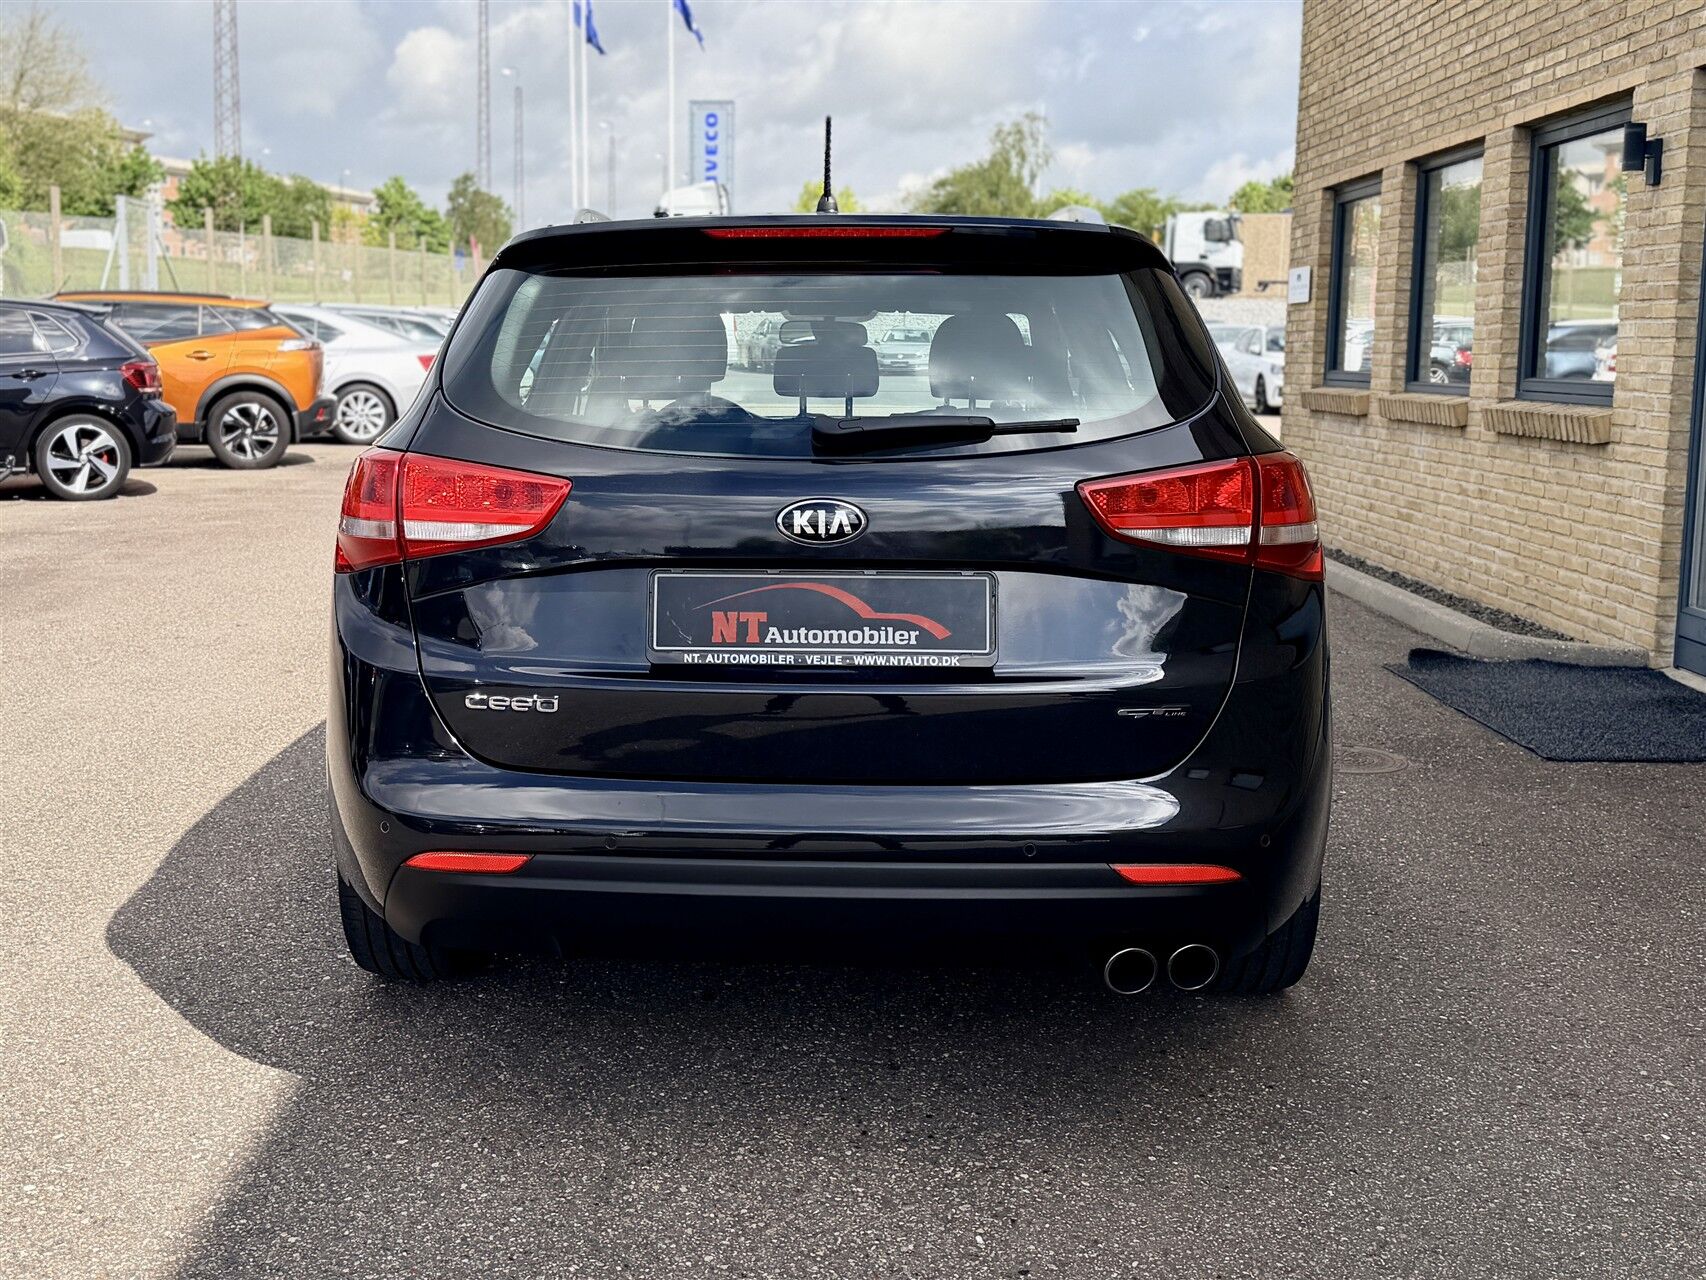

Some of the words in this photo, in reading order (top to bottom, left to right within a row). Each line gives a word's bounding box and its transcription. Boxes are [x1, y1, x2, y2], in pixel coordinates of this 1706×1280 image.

[705, 113, 718, 182] IVECO
[793, 509, 852, 534] KIA
[711, 611, 767, 643] NT
[765, 626, 919, 645] Automobiler
[684, 654, 702, 664] NT.
[706, 654, 795, 665] AUTOMOBILER
[805, 655, 842, 665] VEJLE
[853, 655, 960, 667] WWW.NTAUTO.DK
